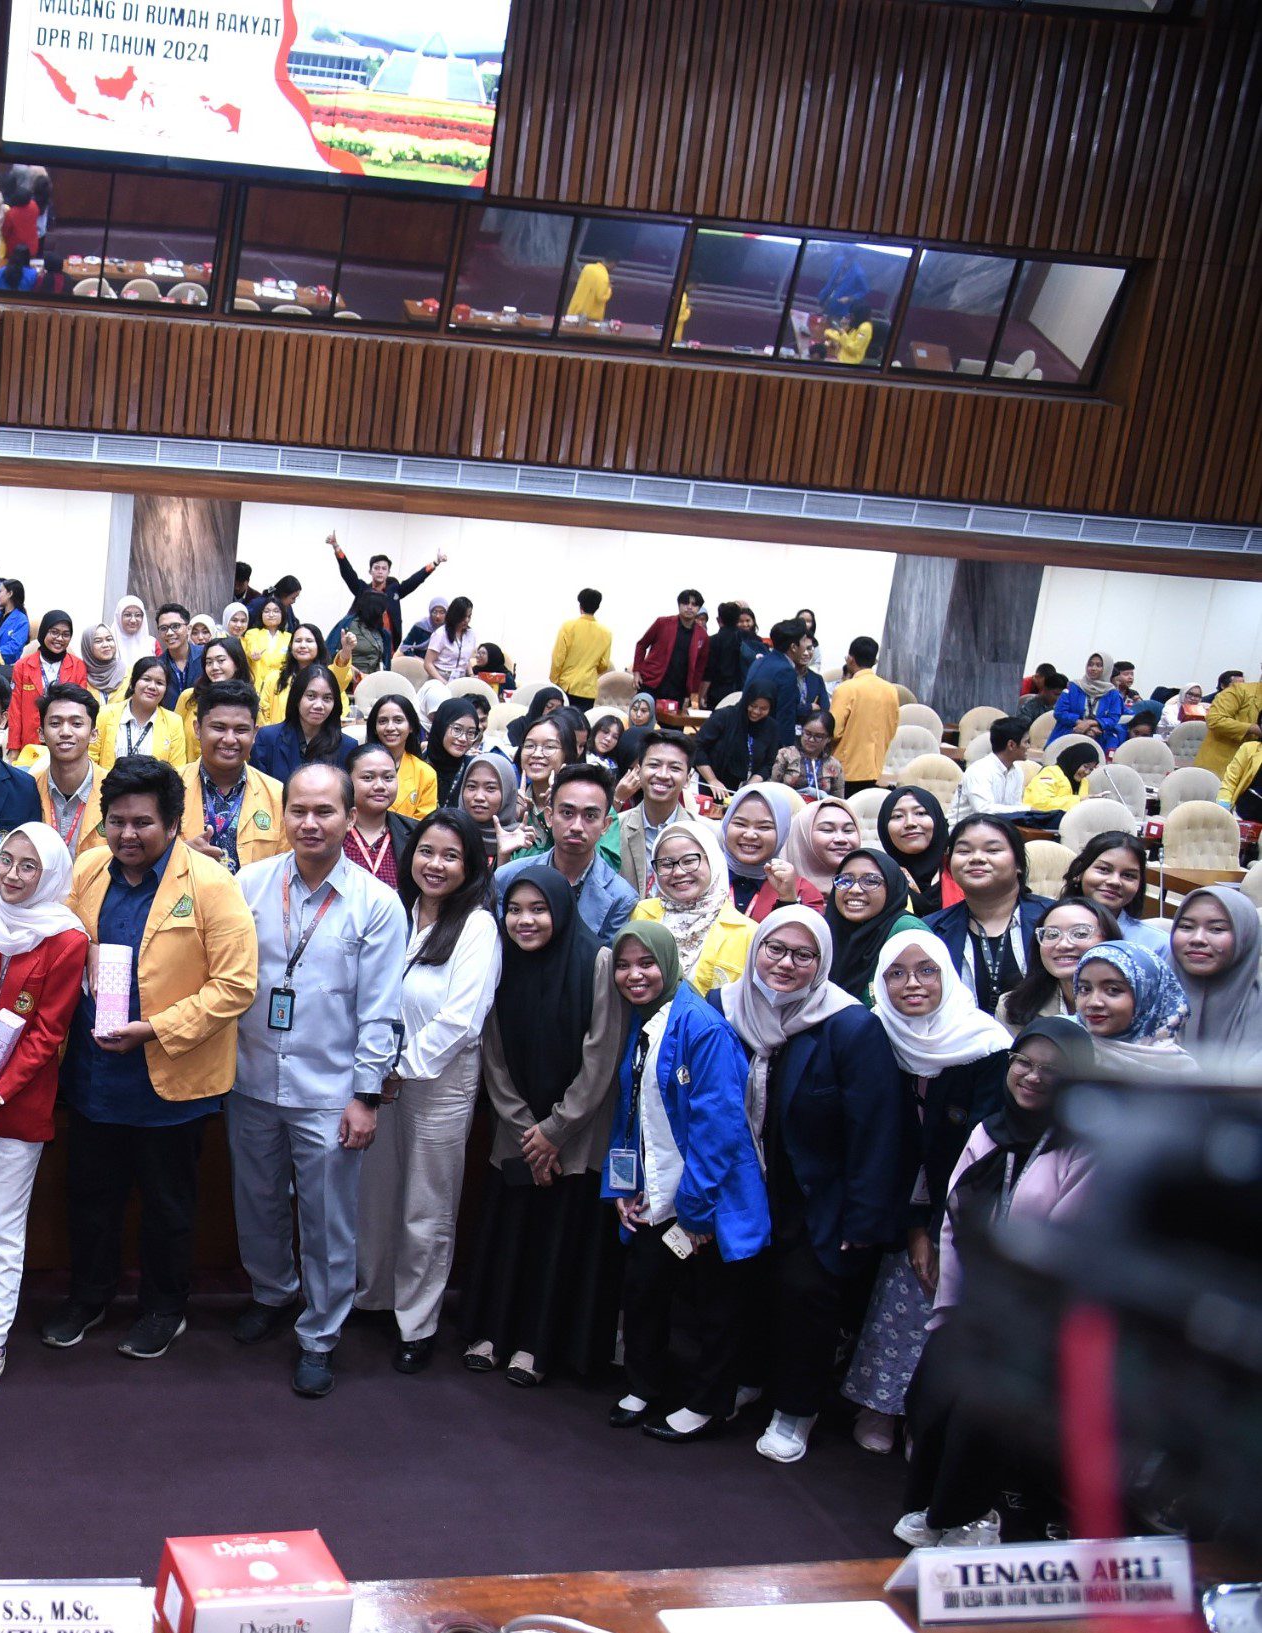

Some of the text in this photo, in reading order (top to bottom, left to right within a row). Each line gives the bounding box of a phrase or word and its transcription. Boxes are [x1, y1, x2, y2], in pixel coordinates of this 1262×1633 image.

[39, 0, 281, 37] MAGANG DI RUMAH RAKYAT
[37, 27, 209, 62] DPR RI TAHUN 2024
[954, 1557, 1162, 1586] TENAGA AHLI
[2, 1599, 43, 1623] S.S.,
[50, 1599, 99, 1621] M.Sc.
